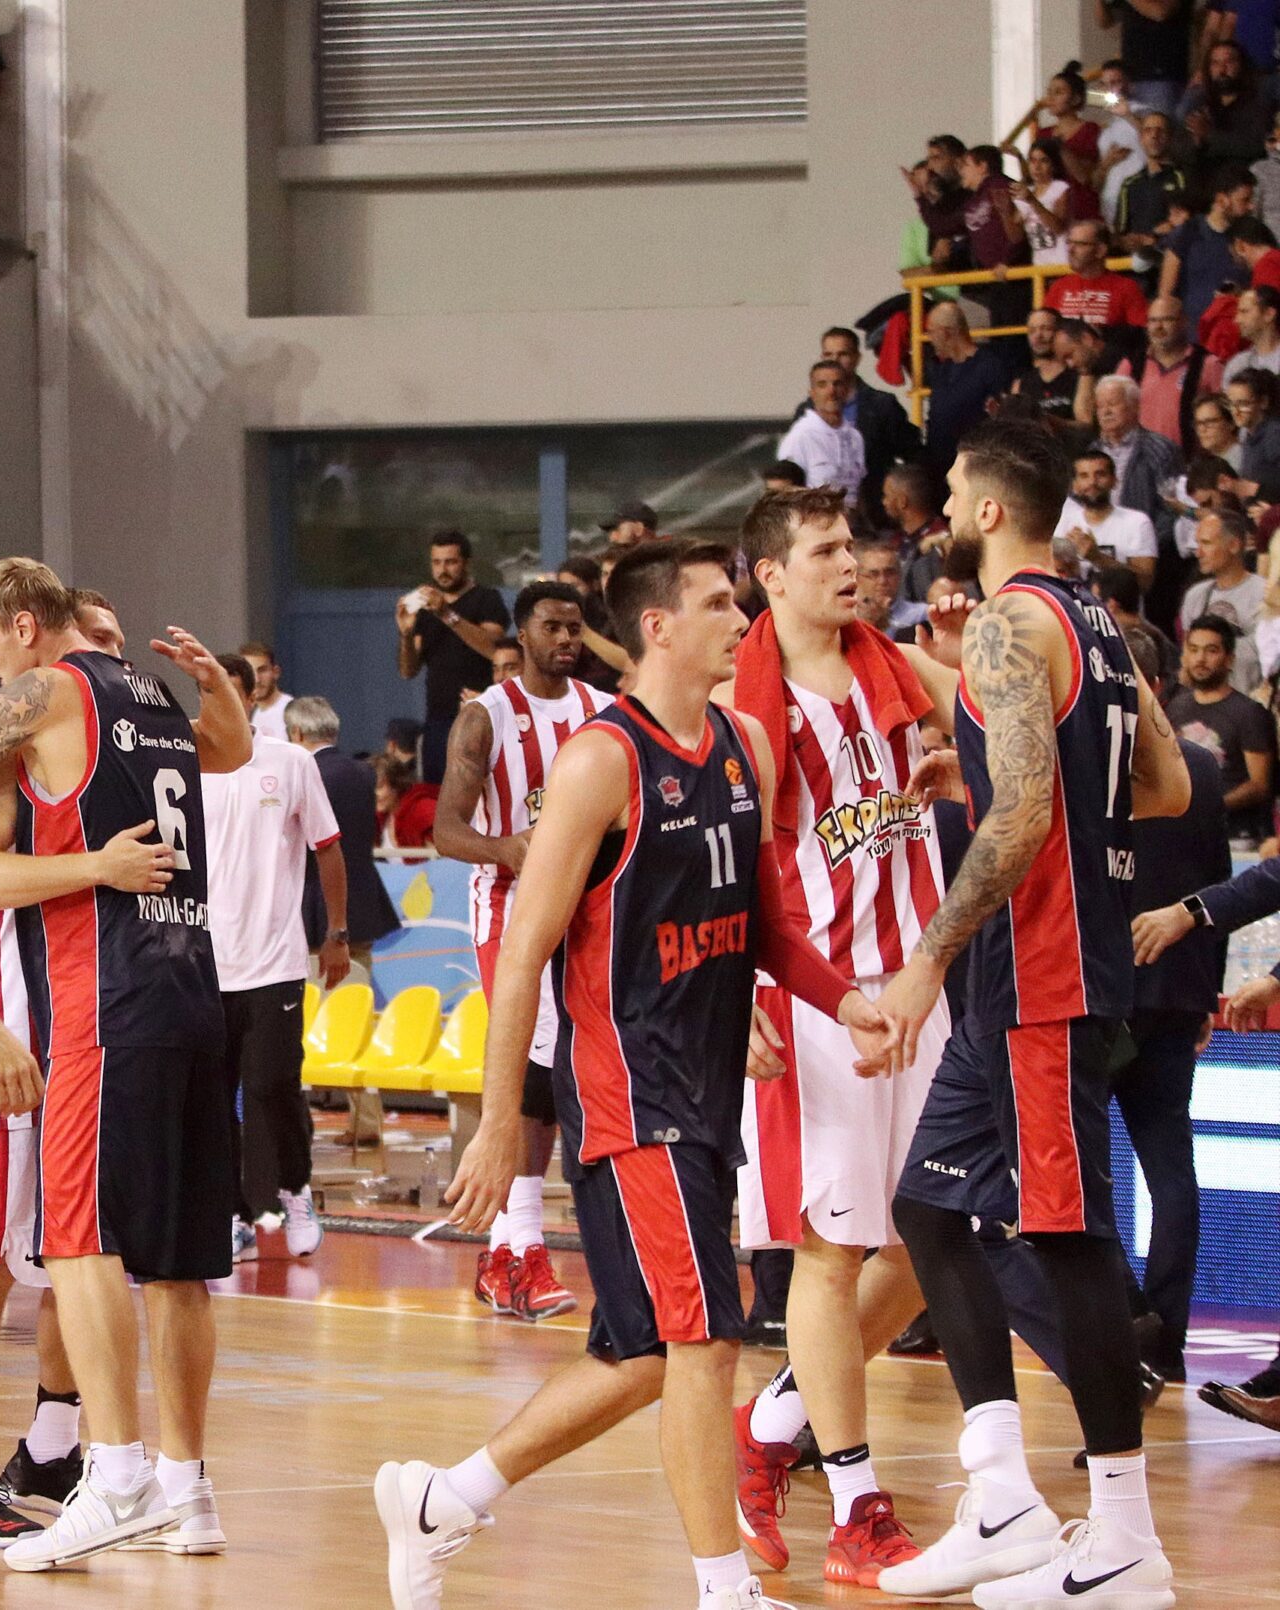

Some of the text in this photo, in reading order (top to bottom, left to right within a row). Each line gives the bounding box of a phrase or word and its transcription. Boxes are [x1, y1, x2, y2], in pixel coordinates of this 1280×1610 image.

[138, 734, 159, 748] Save
[159, 736, 173, 750] the
[839, 730, 884, 786] 10
[153, 768, 191, 870] 6
[661, 815, 698, 832] KELME
[704, 822, 737, 888] 11
[923, 1160, 968, 1178] KELME
